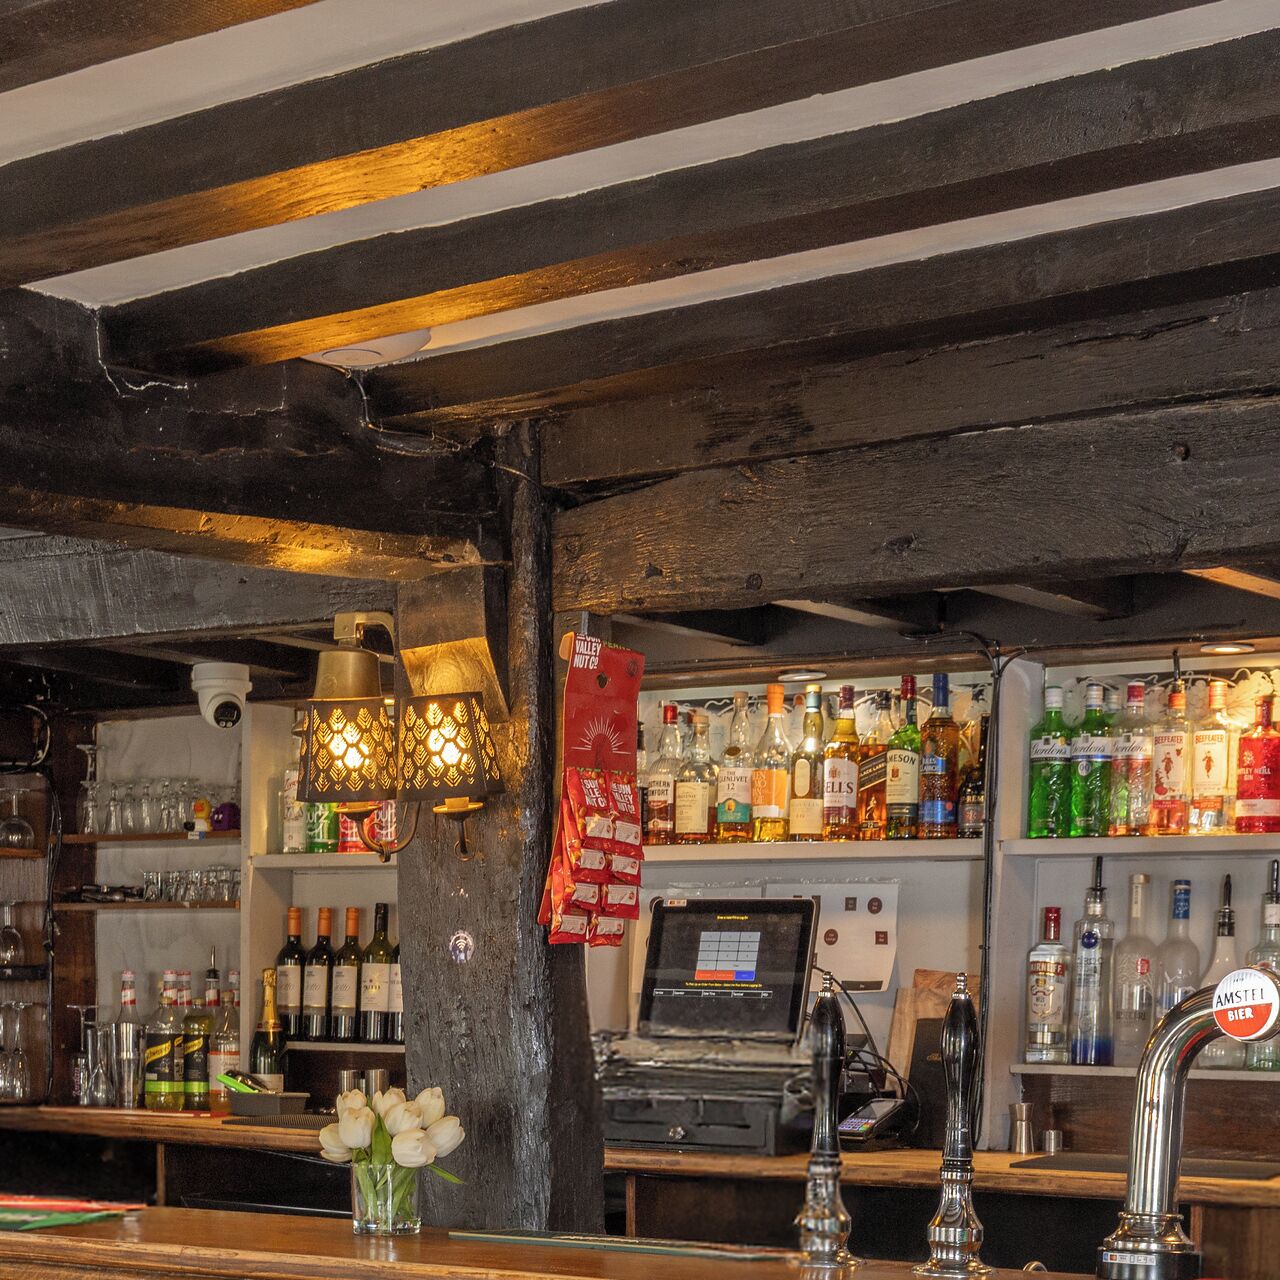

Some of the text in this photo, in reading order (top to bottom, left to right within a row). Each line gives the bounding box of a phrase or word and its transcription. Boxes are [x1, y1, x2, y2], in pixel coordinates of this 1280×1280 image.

[575, 640, 601, 656] VALLEY
[573, 654, 588, 668] NUT
[1154, 735, 1183, 745] BEEFEATER
[1196, 734, 1224, 744] BEEFEATER
[888, 754, 917, 765] MESON
[1215, 988, 1265, 1008] AMSTEL
[1227, 1007, 1254, 1022] BIER
